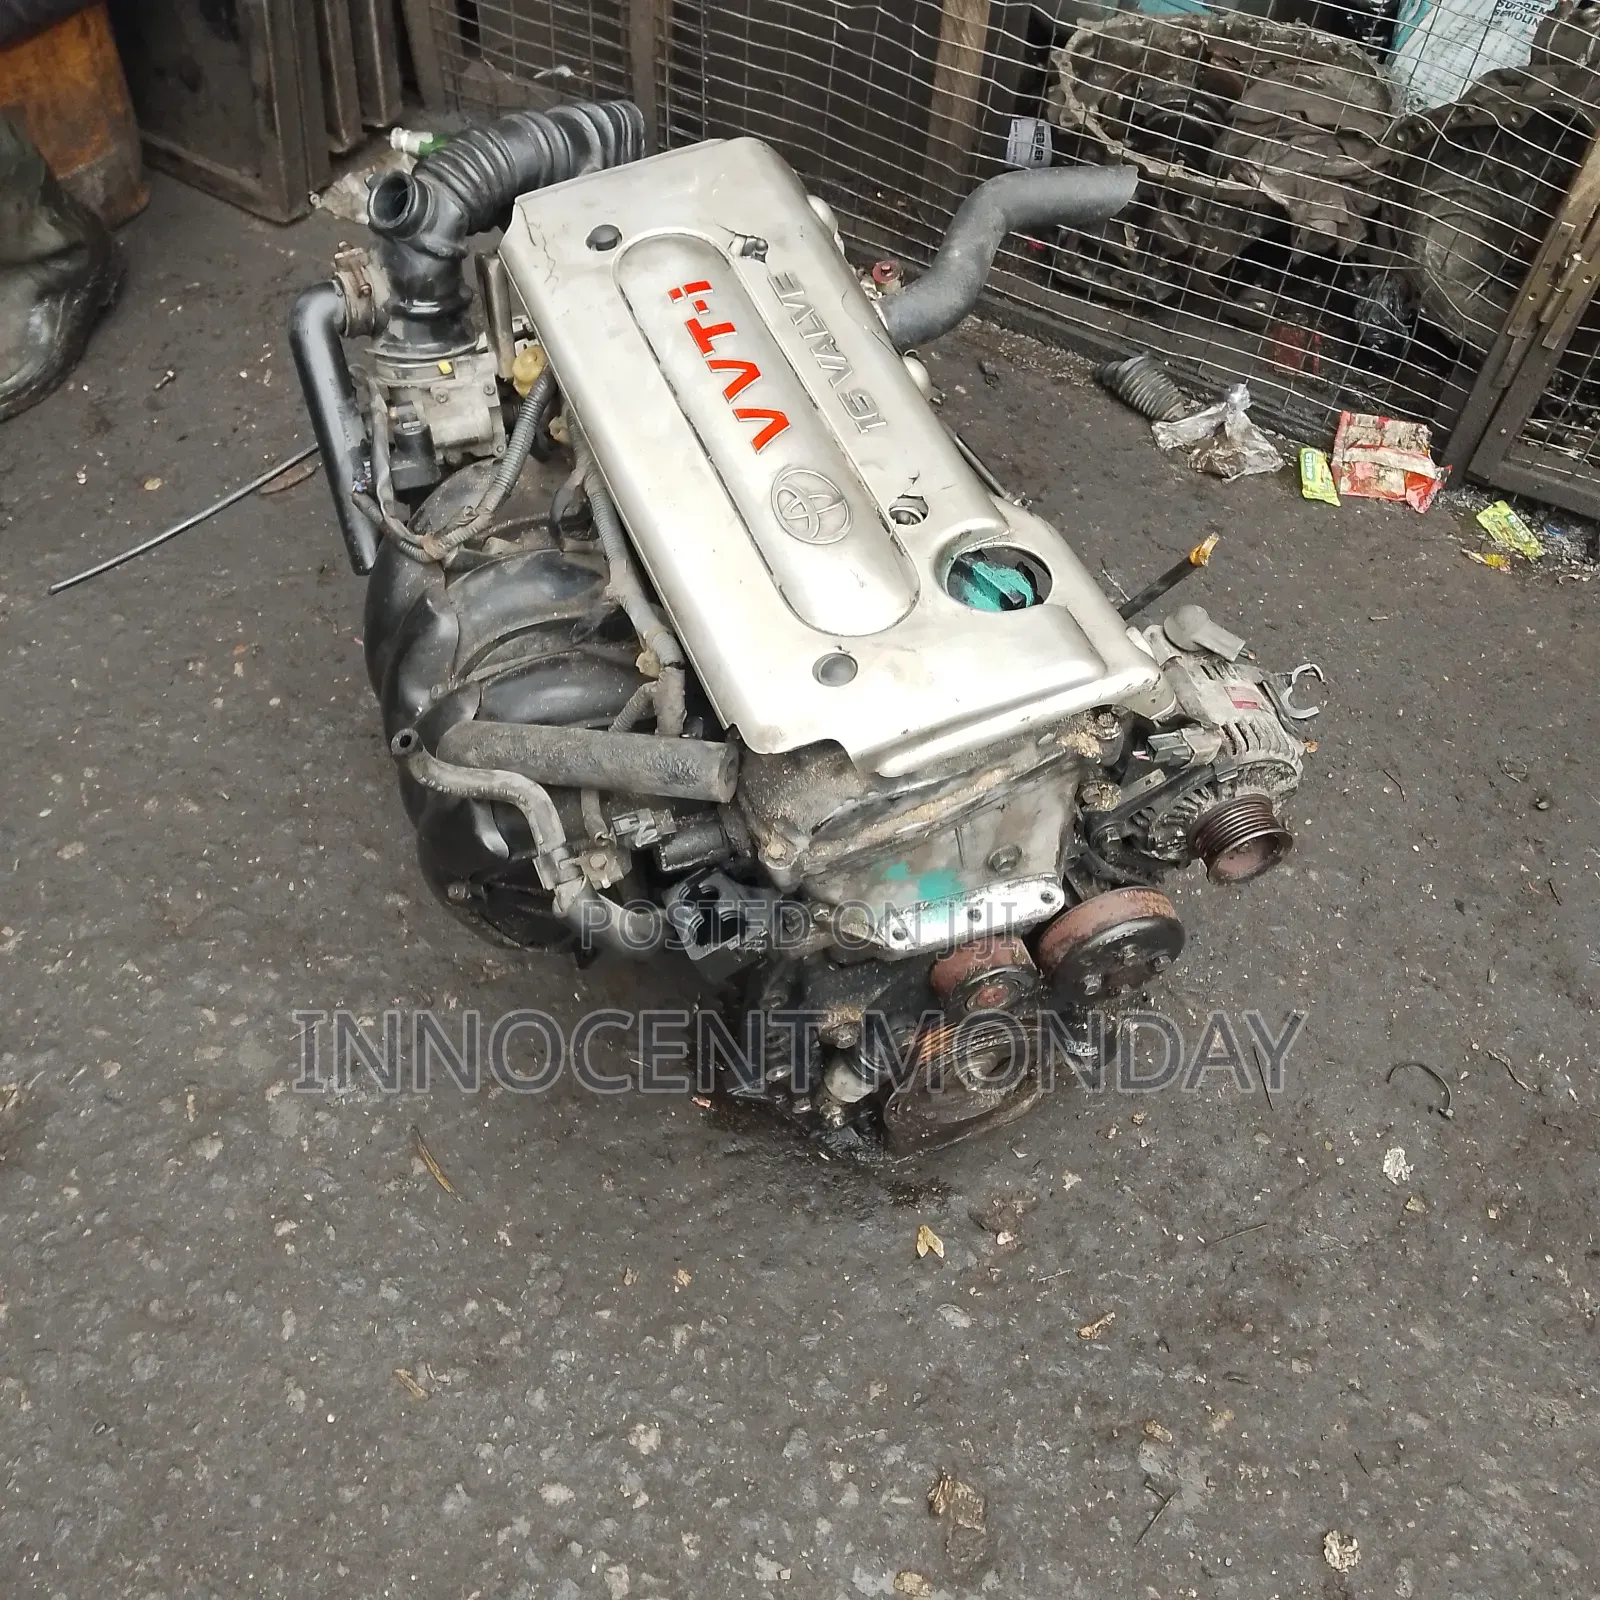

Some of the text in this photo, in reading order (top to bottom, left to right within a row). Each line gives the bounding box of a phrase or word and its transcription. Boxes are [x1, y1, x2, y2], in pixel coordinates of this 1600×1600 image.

[667, 280, 791, 455] VVT-i
[767, 271, 887, 434] 16 VALVE
